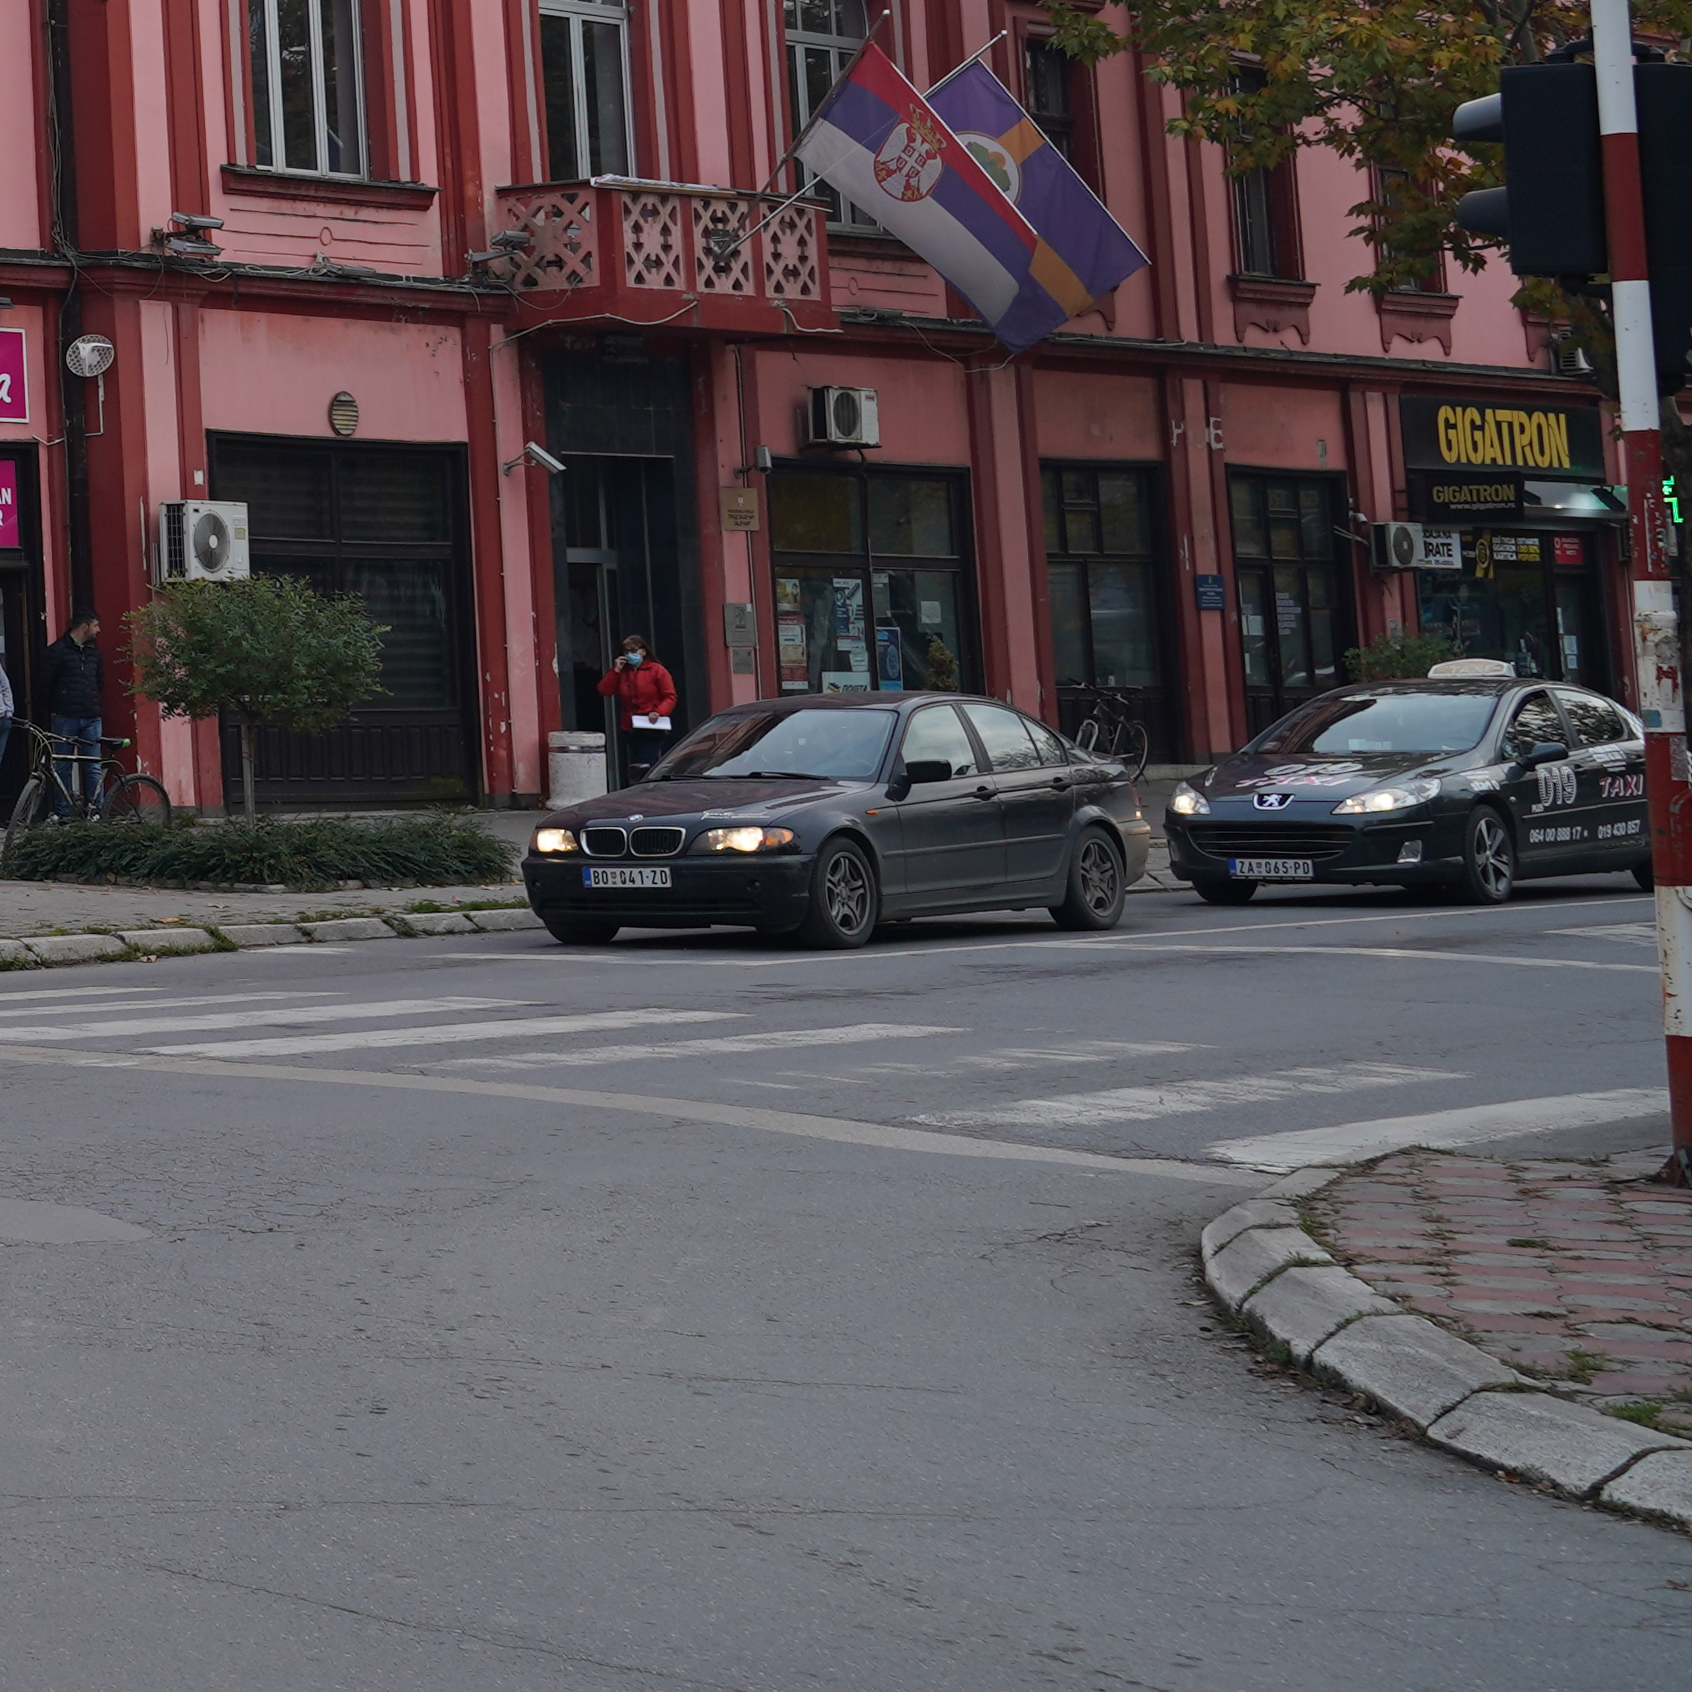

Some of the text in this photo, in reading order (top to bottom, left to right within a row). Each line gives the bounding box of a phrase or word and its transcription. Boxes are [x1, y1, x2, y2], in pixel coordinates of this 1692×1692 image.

[1438, 405, 1570, 468] GIGATRON
[1431, 484, 1515, 503] GIGATRON
[1599, 774, 1644, 797] TAXI
[1529, 829, 1544, 843] 064
[1545, 828, 1556, 842] 00
[1573, 826, 1582, 840] 17
[1598, 824, 1612, 839] 019
